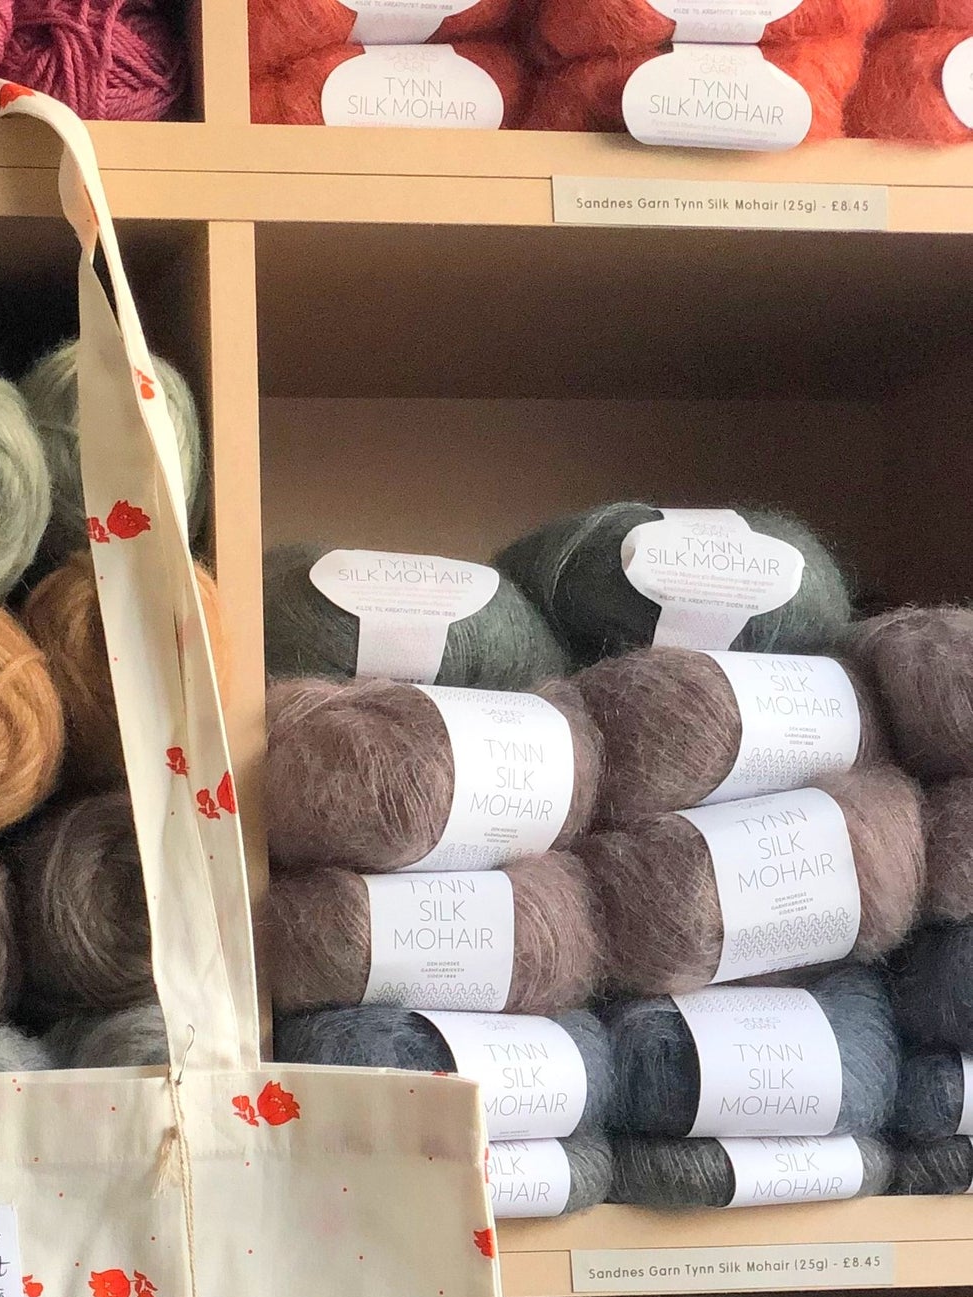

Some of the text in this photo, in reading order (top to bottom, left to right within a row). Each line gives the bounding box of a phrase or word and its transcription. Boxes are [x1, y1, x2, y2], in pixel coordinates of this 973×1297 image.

[384, 77, 442, 97] TYNN
[689, 78, 749, 101] TYNN
[347, 95, 477, 121] SILK MOHAIR
[649, 94, 784, 125] SILK MOHAIR
[576, 198, 633, 209] Sandnes
[638, 198, 670, 209] Garn
[674, 198, 704, 211] Tynn
[708, 198, 729, 210] Silk
[735, 199, 779, 211] Mohair
[783, 200, 817, 213] (25g)
[831, 200, 869, 212] £8.45
[682, 537, 743, 555] TYNN
[376, 559, 435, 571] TYNN
[647, 548, 780, 576] SILK MOHAIR
[338, 569, 474, 585] SILK MOHAIR
[747, 659, 814, 672] TYNN
[770, 675, 815, 693] SILK
[756, 696, 844, 718] MOHAIR
[483, 739, 543, 763] TYNN
[495, 766, 534, 791] SILK
[469, 792, 553, 821] MOHAIR
[735, 808, 808, 835] TYNN
[757, 831, 805, 860] SILK
[738, 853, 835, 893] MOHAIR
[410, 879, 475, 894] TYNN
[419, 900, 466, 921] SILK
[394, 928, 493, 950] MOHAIR
[483, 1043, 549, 1062] TYNN
[733, 1043, 804, 1062] TYNN
[502, 1066, 545, 1089] SILK
[748, 1068, 795, 1090] SILK
[484, 1093, 568, 1116] MOHAIR
[719, 1096, 820, 1116] MOHAIR
[492, 1140, 529, 1152] NN
[775, 1152, 819, 1173] SILK
[490, 1181, 551, 1203] HAIR
[752, 1176, 843, 1199] MOHAIR
[589, 1267, 645, 1279] Sandnes
[649, 1265, 681, 1277] Garn
[685, 1264, 714, 1278] Tynn
[719, 1262, 741, 1274] Silk
[747, 1260, 790, 1272] Mohair
[795, 1258, 828, 1272] (25g)
[843, 1256, 881, 1268] £8.45
